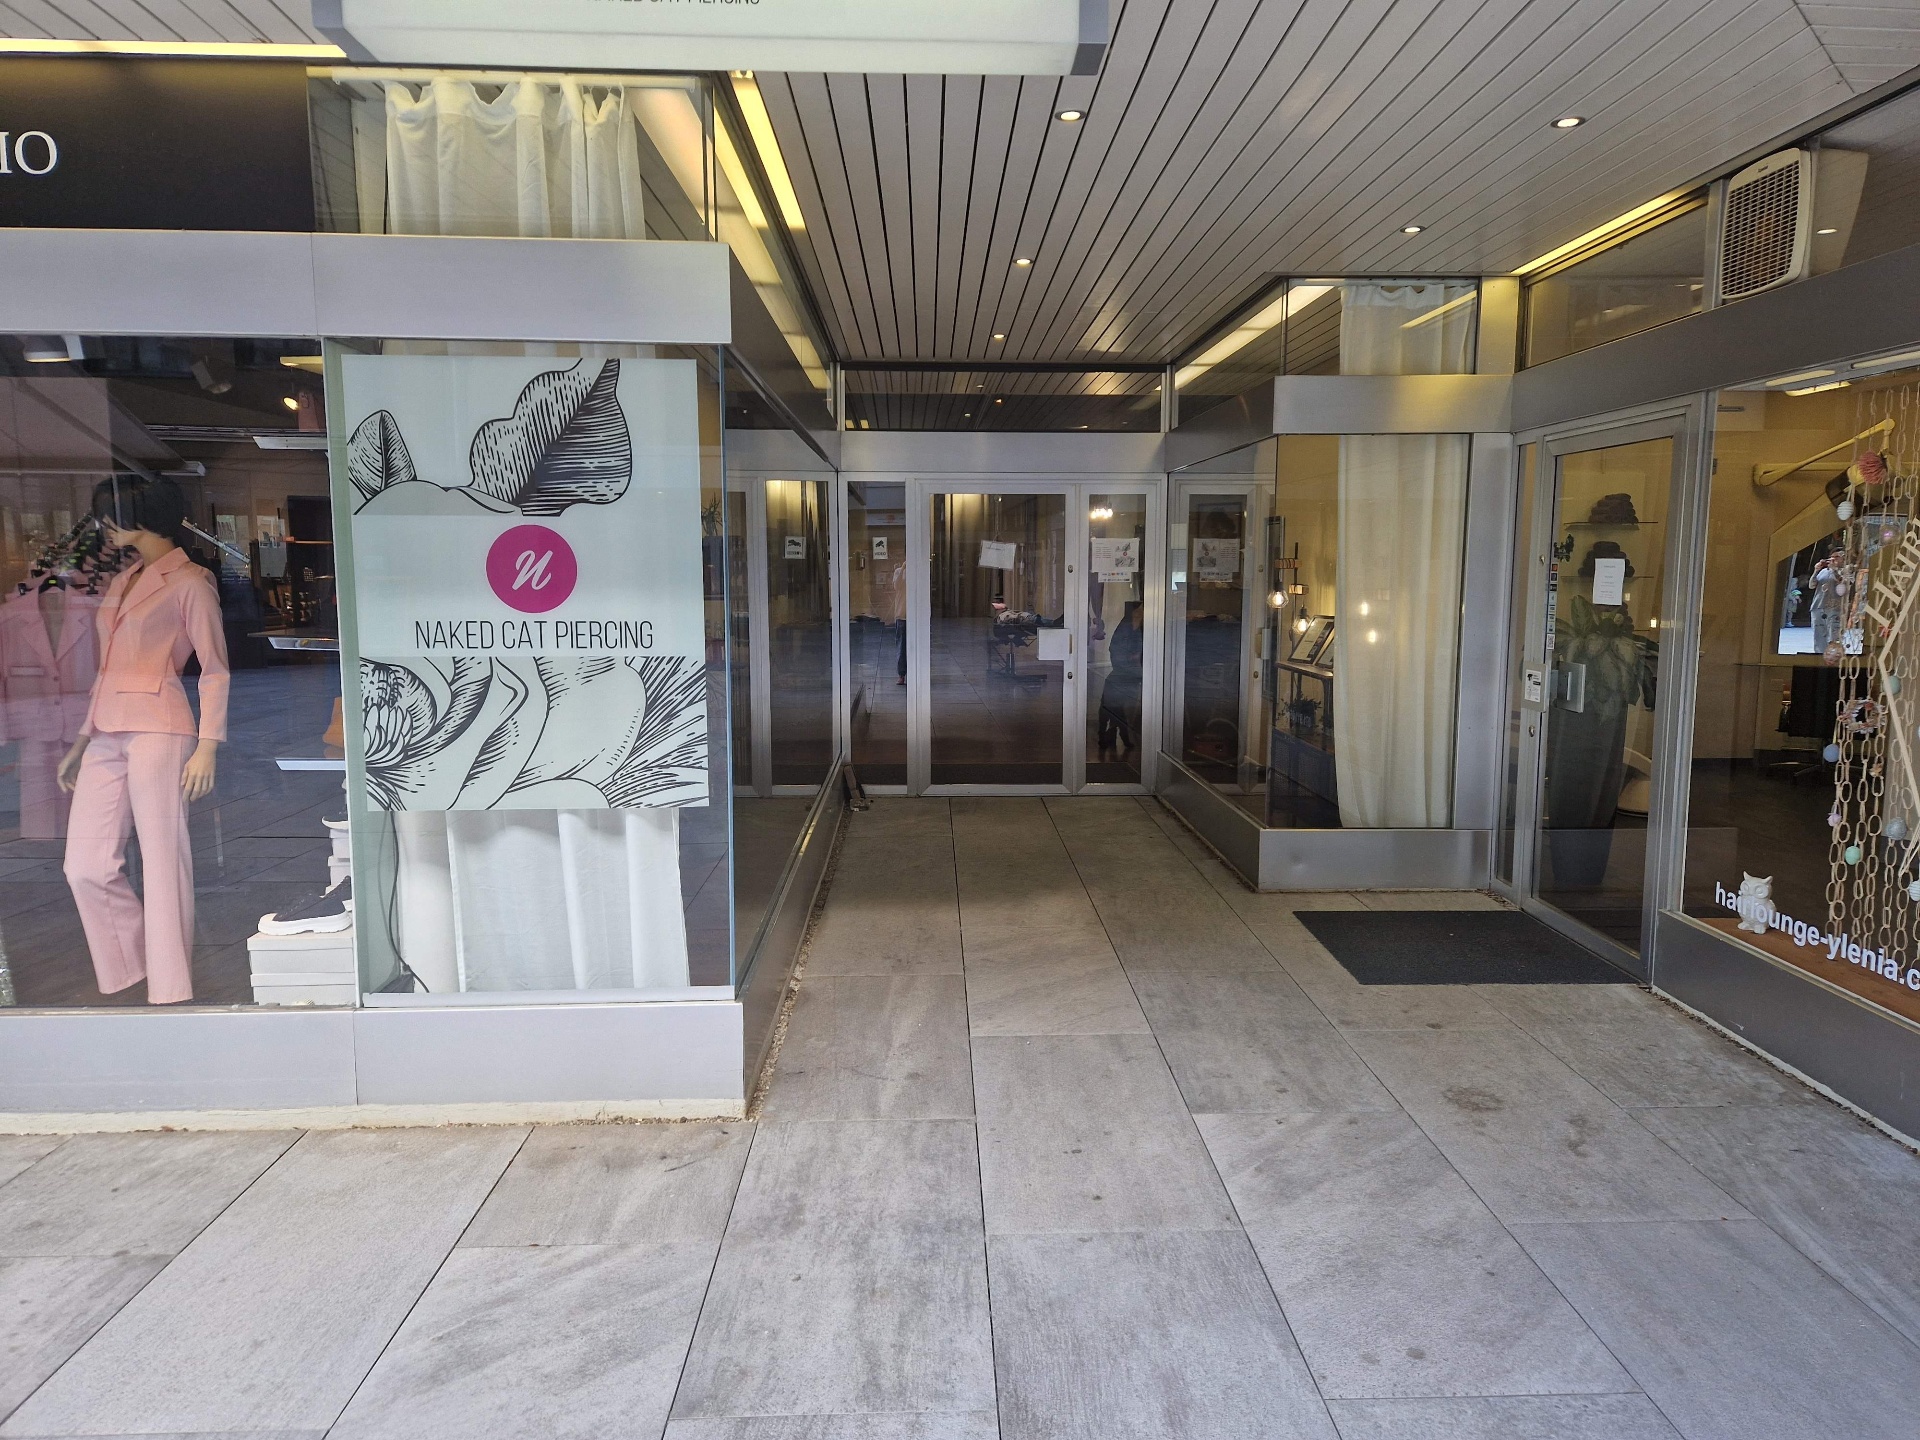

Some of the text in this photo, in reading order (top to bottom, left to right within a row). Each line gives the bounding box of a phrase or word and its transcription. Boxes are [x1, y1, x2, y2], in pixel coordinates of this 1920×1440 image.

[415, 620, 653, 649] NAKED CAT PIERCING
